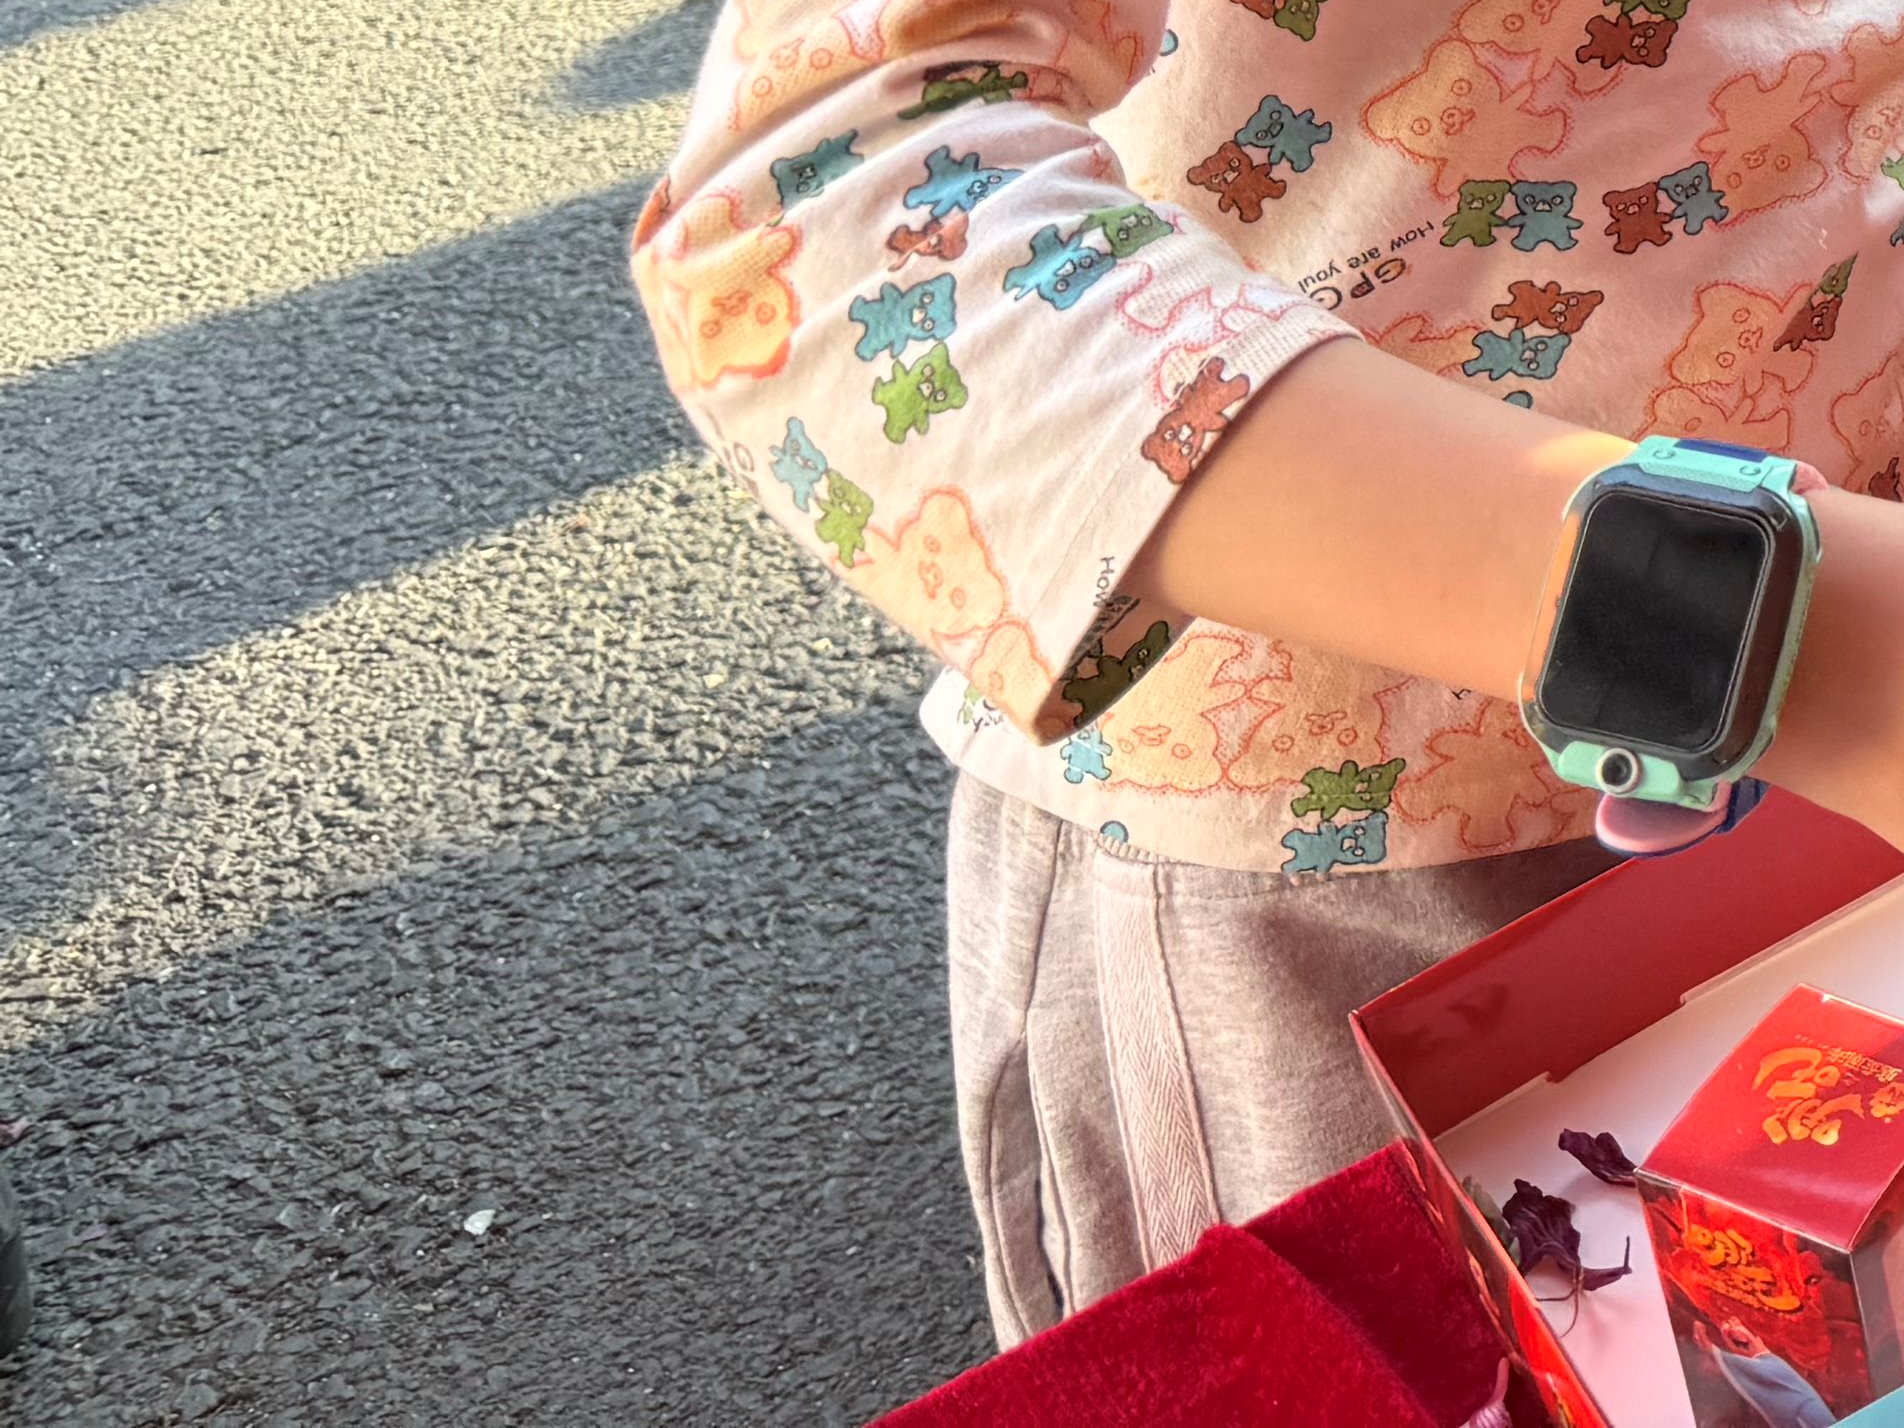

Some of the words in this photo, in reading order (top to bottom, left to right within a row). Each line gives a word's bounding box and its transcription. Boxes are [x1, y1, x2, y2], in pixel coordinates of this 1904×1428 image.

[1389, 219, 1435, 253] How
[1347, 246, 1382, 269] are
[1308, 256, 1407, 311] GPG
